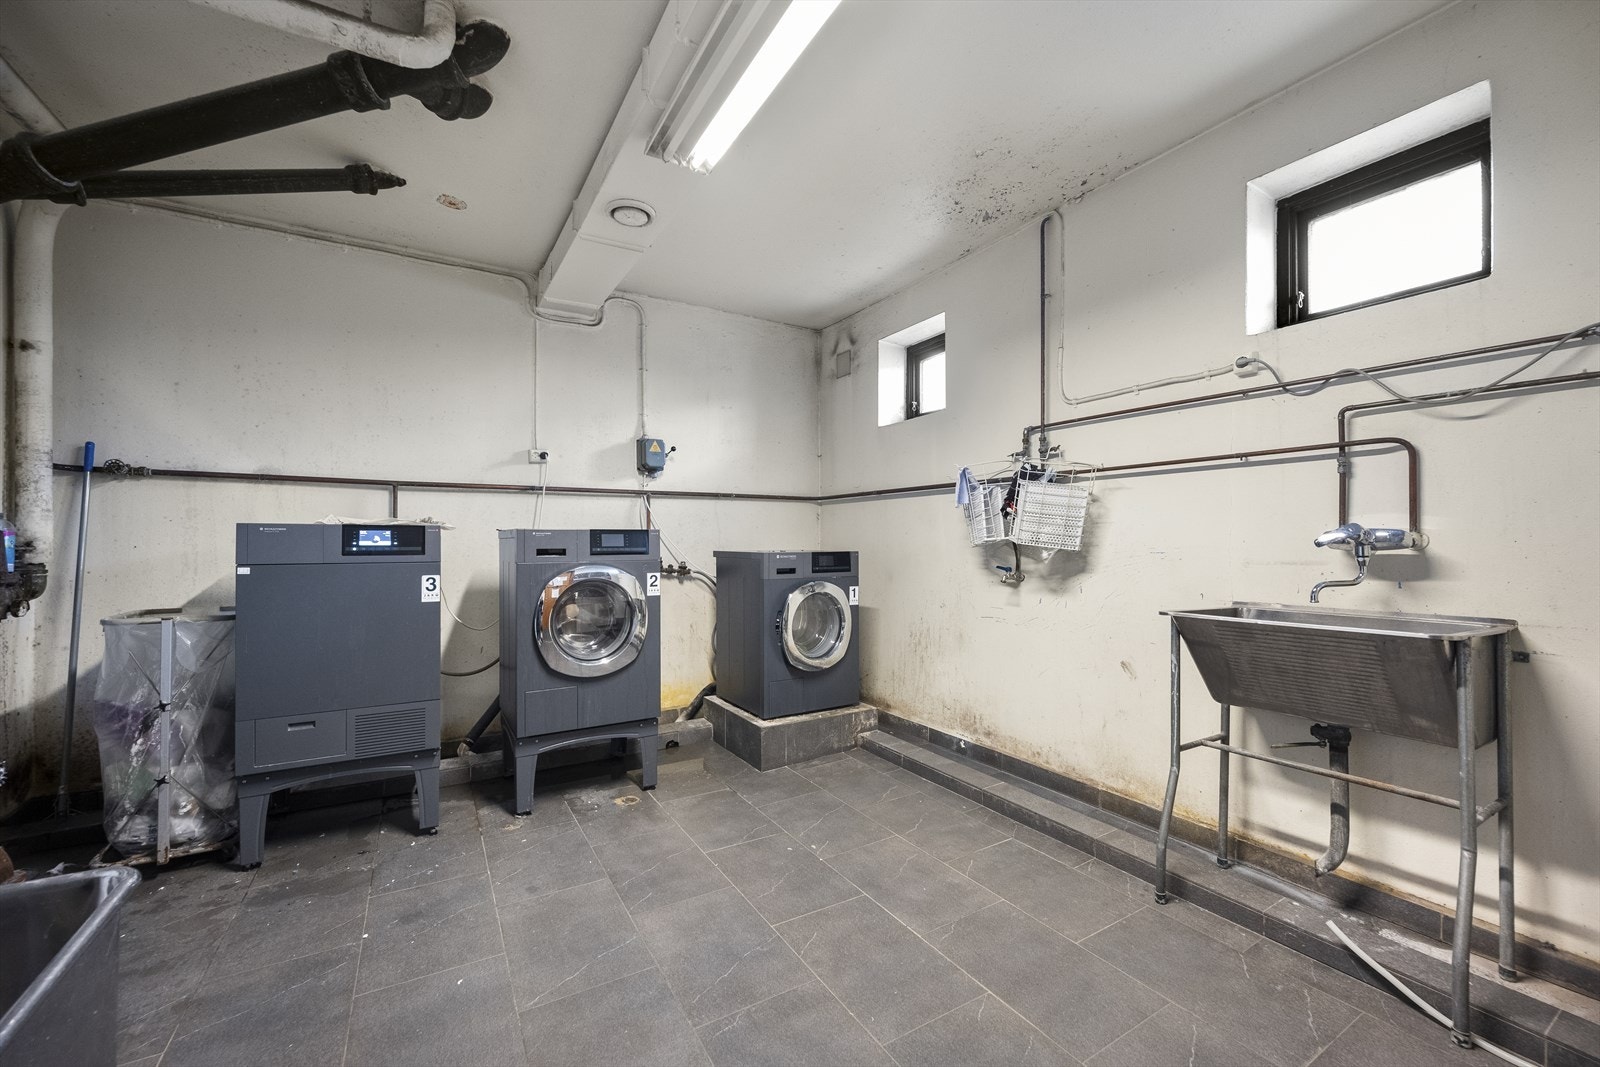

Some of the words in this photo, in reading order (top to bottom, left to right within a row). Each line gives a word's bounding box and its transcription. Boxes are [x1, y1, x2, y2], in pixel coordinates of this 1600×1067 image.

[425, 576, 437, 592] 3
[649, 574, 658, 588] 2
[851, 587, 856, 598] 1
